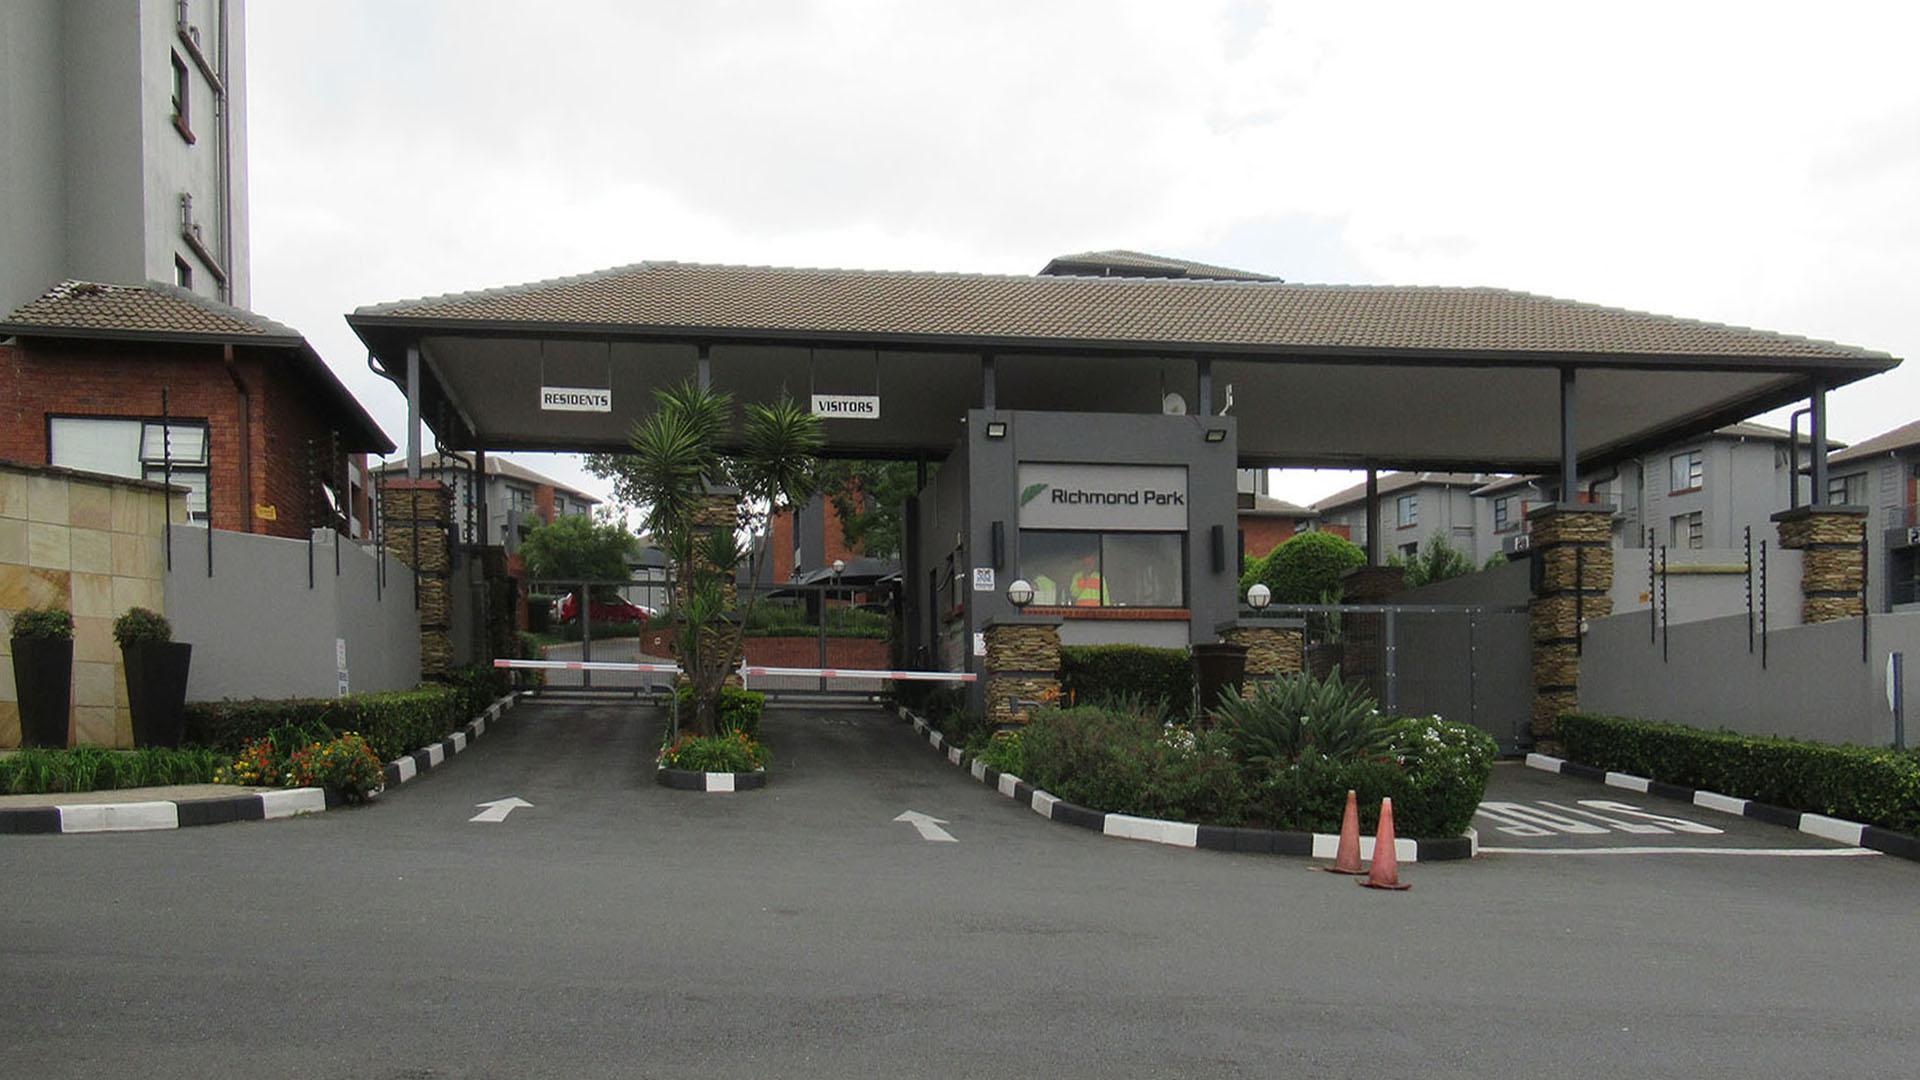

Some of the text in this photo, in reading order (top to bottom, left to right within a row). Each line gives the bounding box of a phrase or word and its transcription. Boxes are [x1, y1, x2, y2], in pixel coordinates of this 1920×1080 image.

[544, 393, 608, 406] RESIDENTS
[818, 401, 873, 412] VISITORS
[1052, 489, 1184, 506] Richmond Park
[1475, 800, 1725, 837] STOP
